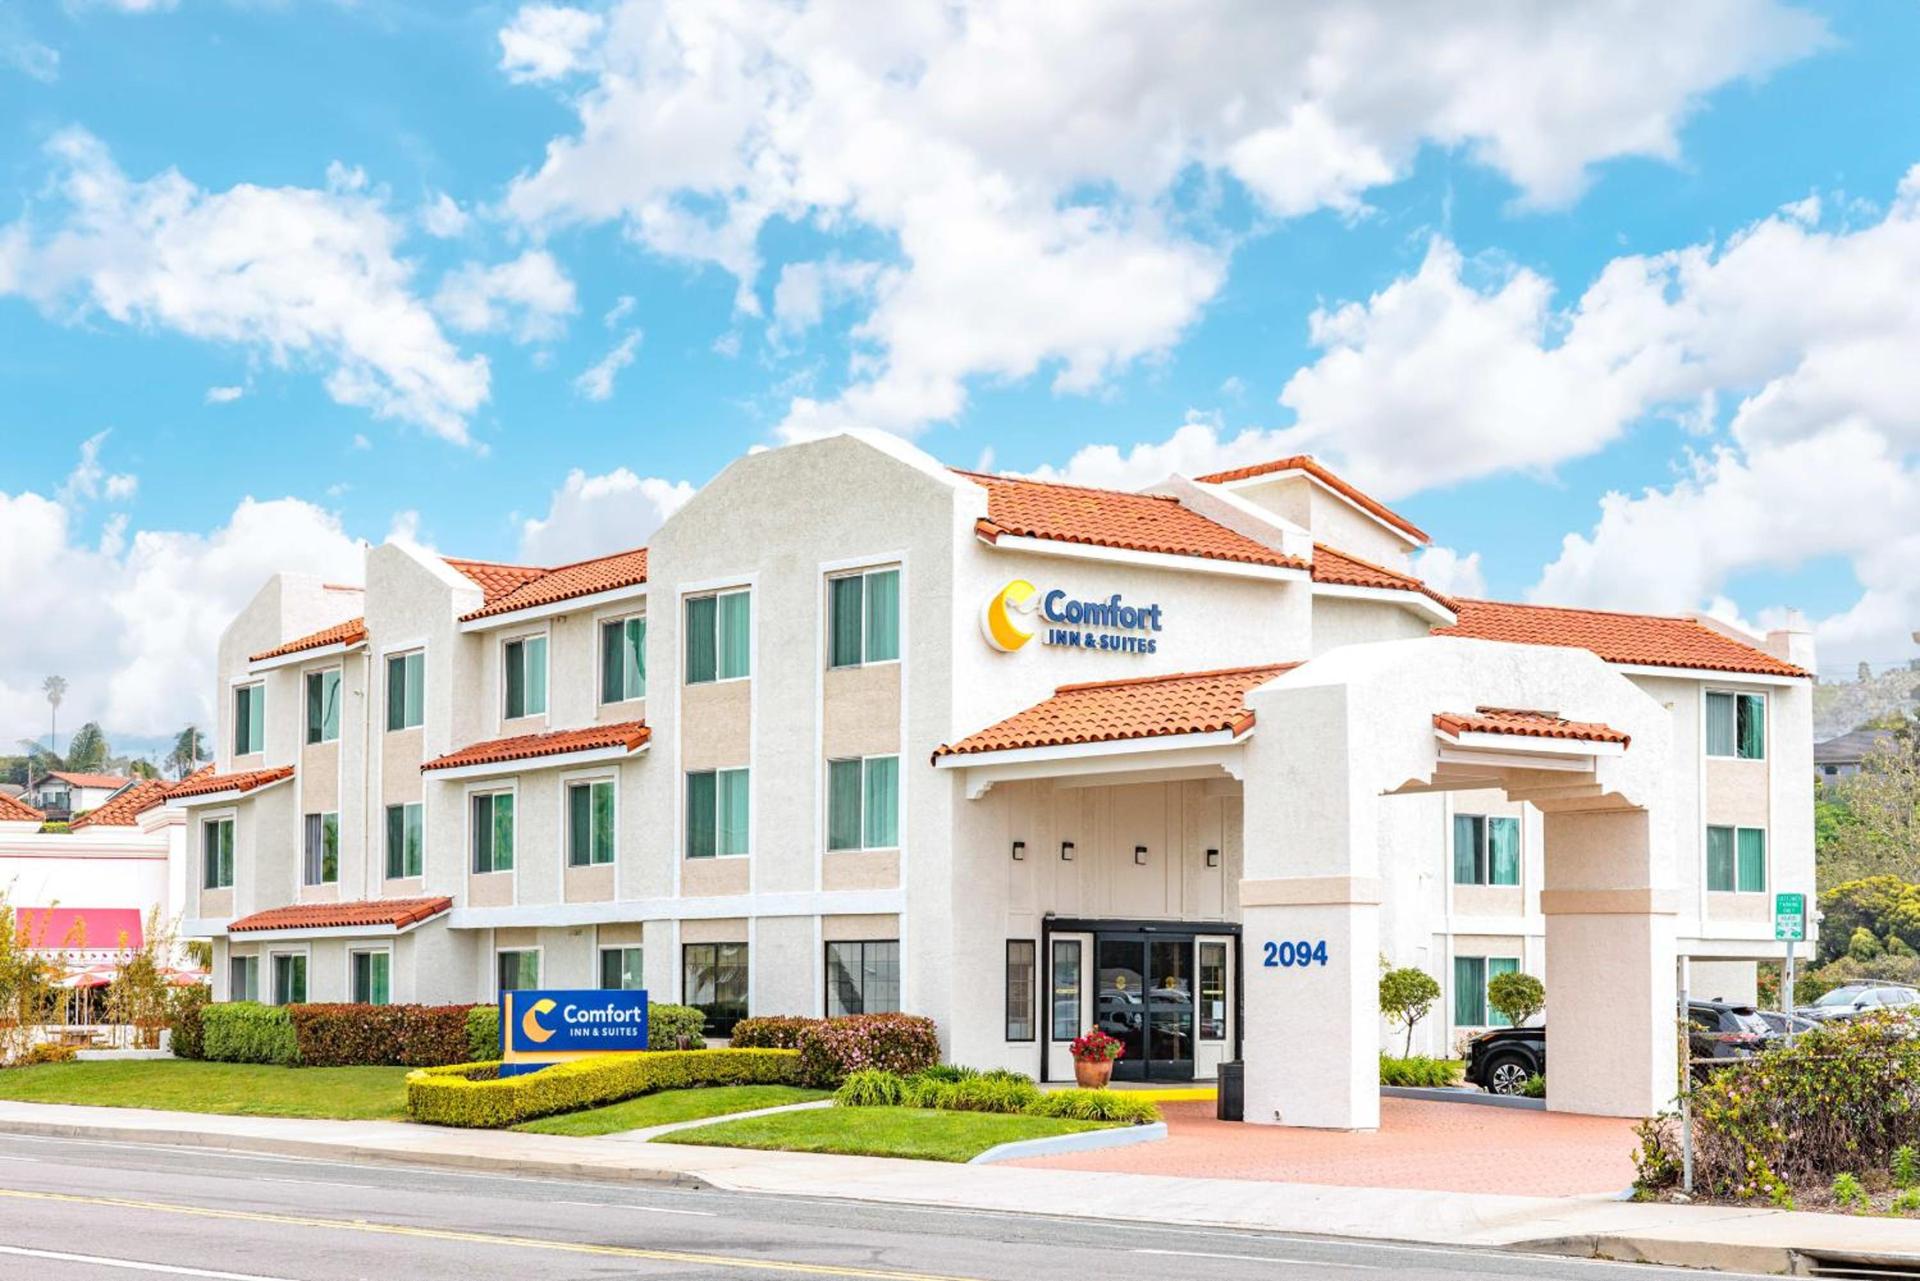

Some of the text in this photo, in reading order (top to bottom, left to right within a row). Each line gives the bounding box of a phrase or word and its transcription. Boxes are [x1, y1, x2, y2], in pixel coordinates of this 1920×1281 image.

[1044, 589, 1162, 631] Comfort
[1049, 629, 1157, 654] INN & SUITES
[1263, 940, 1328, 967] 2094
[563, 1003, 642, 1023] Comfort
[570, 1027, 638, 1037] INN & SUITES
